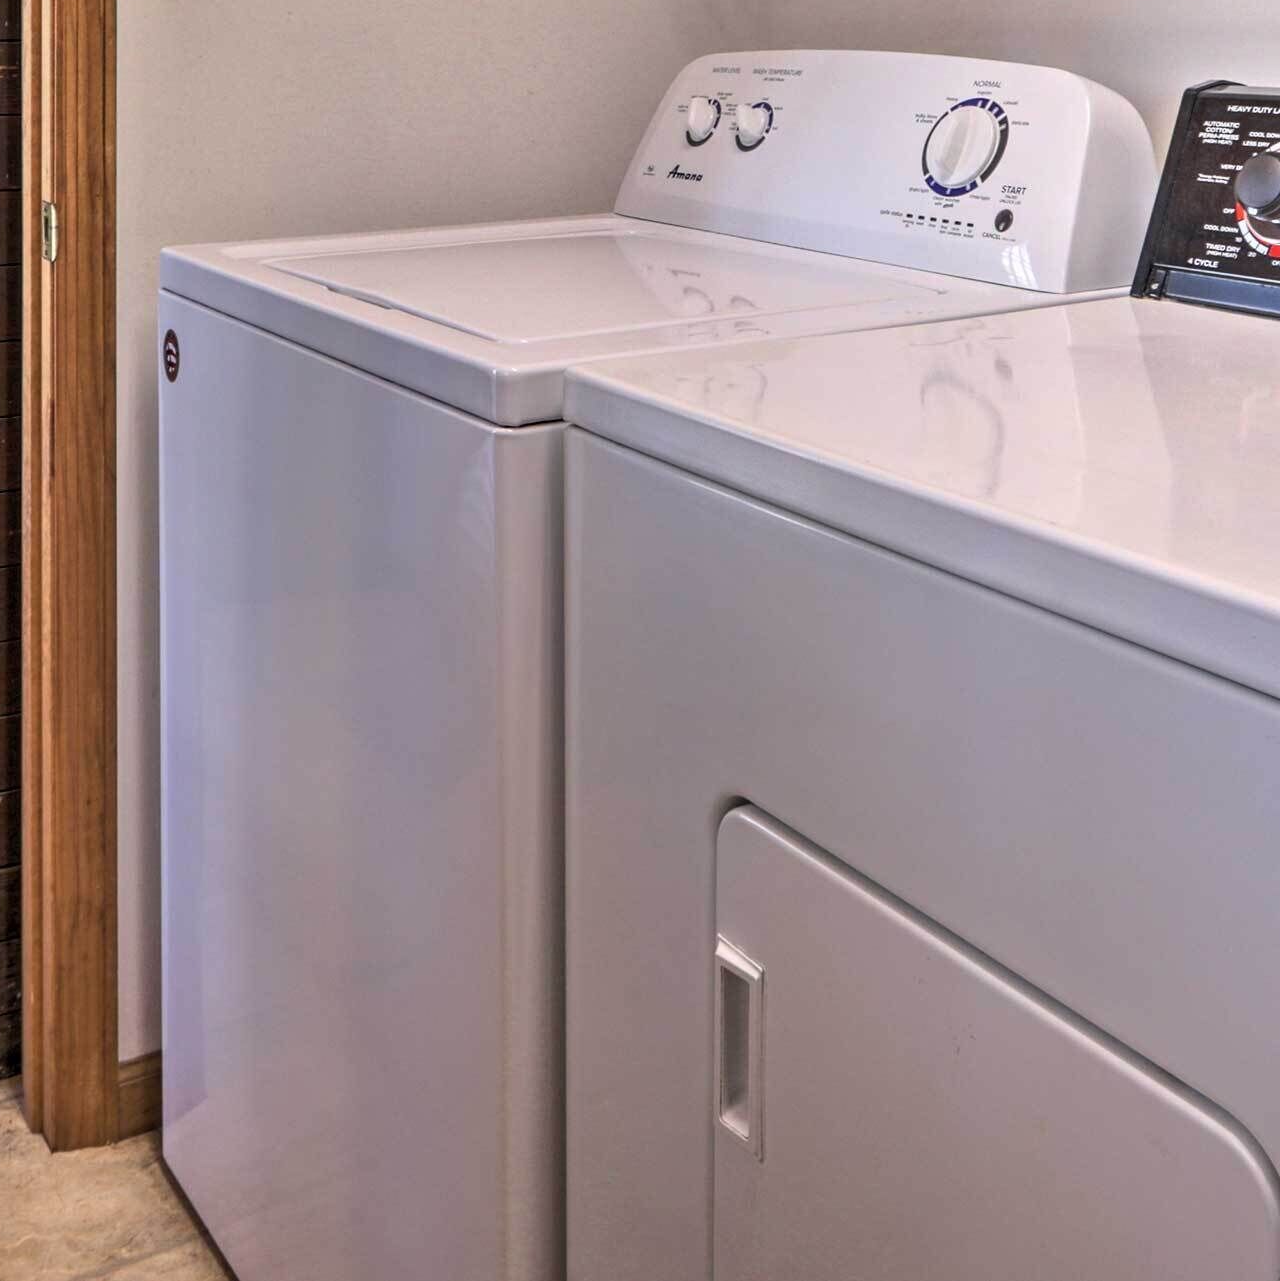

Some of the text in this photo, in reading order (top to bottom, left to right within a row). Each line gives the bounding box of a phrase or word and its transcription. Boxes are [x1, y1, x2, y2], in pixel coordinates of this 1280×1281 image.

[973, 80, 1001, 88] NORMAL
[1227, 104, 1252, 113] HEAVY
[1252, 106, 1272, 114] DUTY
[1203, 120, 1240, 129] AUTOMATIC
[666, 164, 704, 182] Amana
[1001, 184, 1028, 195] START
[1220, 225, 1239, 233] DOWN
[982, 232, 1001, 241] CANCEL
[1205, 243, 1241, 253] TIMED DRY
[1194, 258, 1219, 268] CYCLE
